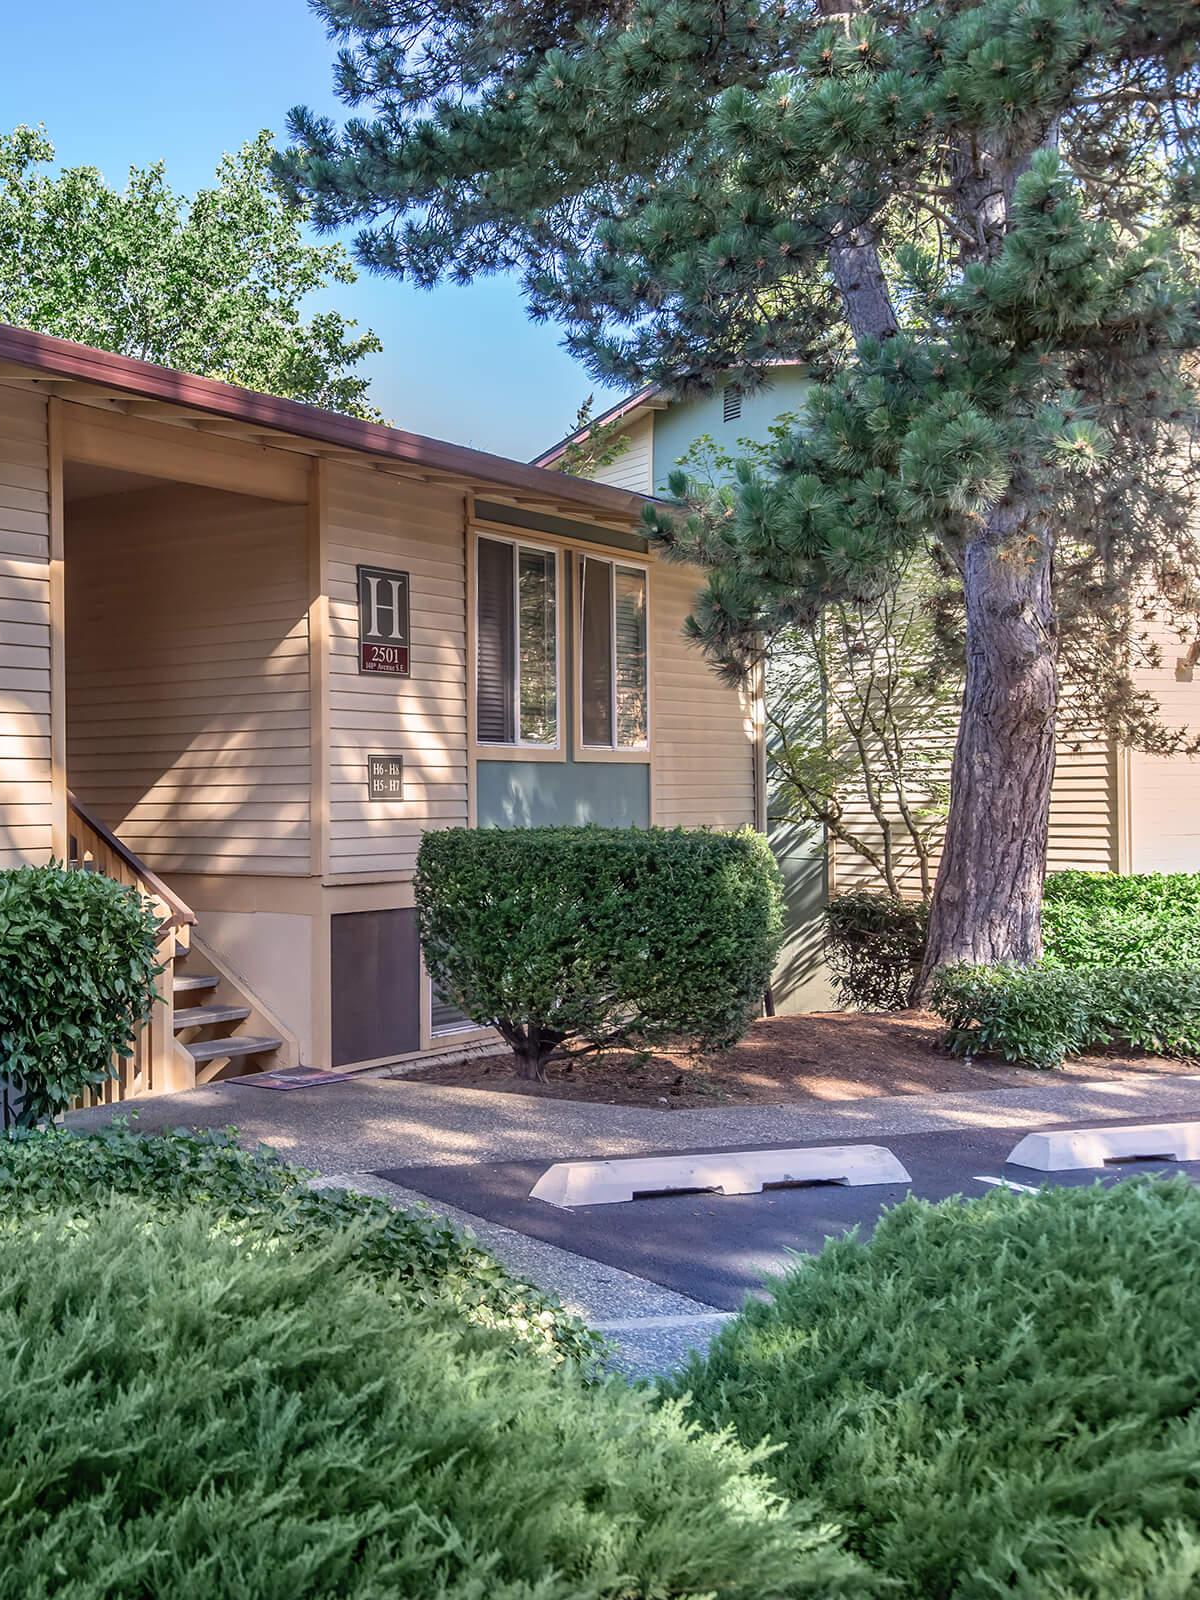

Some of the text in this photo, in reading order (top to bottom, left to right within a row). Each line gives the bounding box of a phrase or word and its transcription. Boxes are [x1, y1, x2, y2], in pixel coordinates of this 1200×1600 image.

[365, 576, 404, 639] H
[371, 646, 399, 663] 2501
[373, 763, 384, 775] H6
[373, 779, 384, 792] H5
[389, 779, 400, 792] H7
